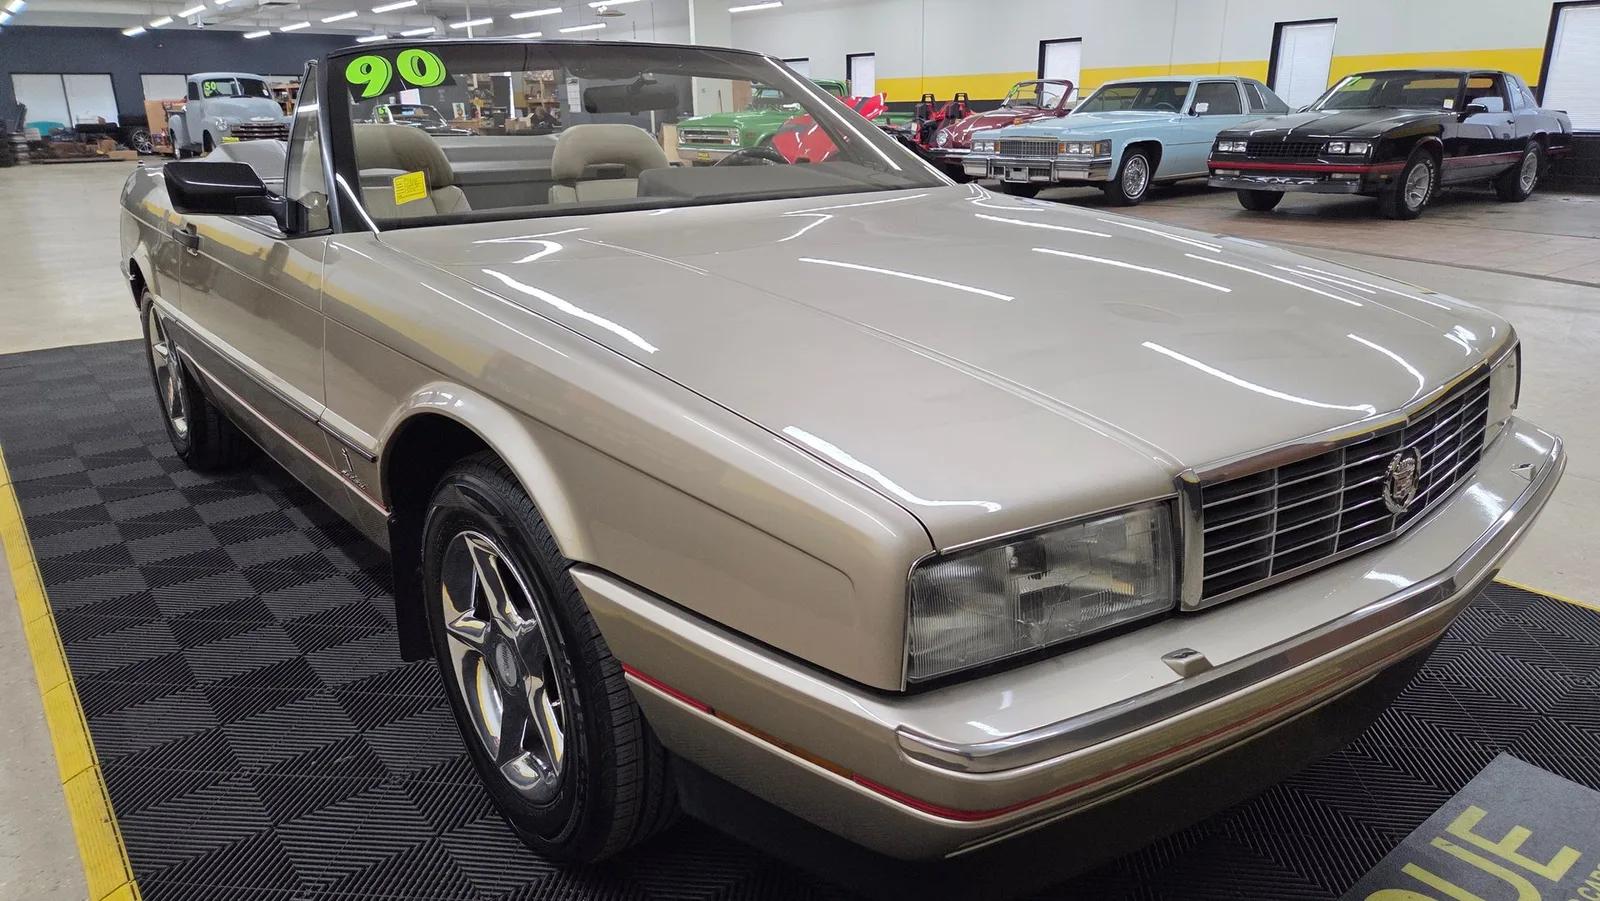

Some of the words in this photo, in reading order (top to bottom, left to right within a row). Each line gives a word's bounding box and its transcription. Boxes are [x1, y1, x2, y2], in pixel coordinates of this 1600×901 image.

[204, 81, 217, 91] 50
[345, 48, 447, 98] 90
[1364, 805, 1583, 901] UE
